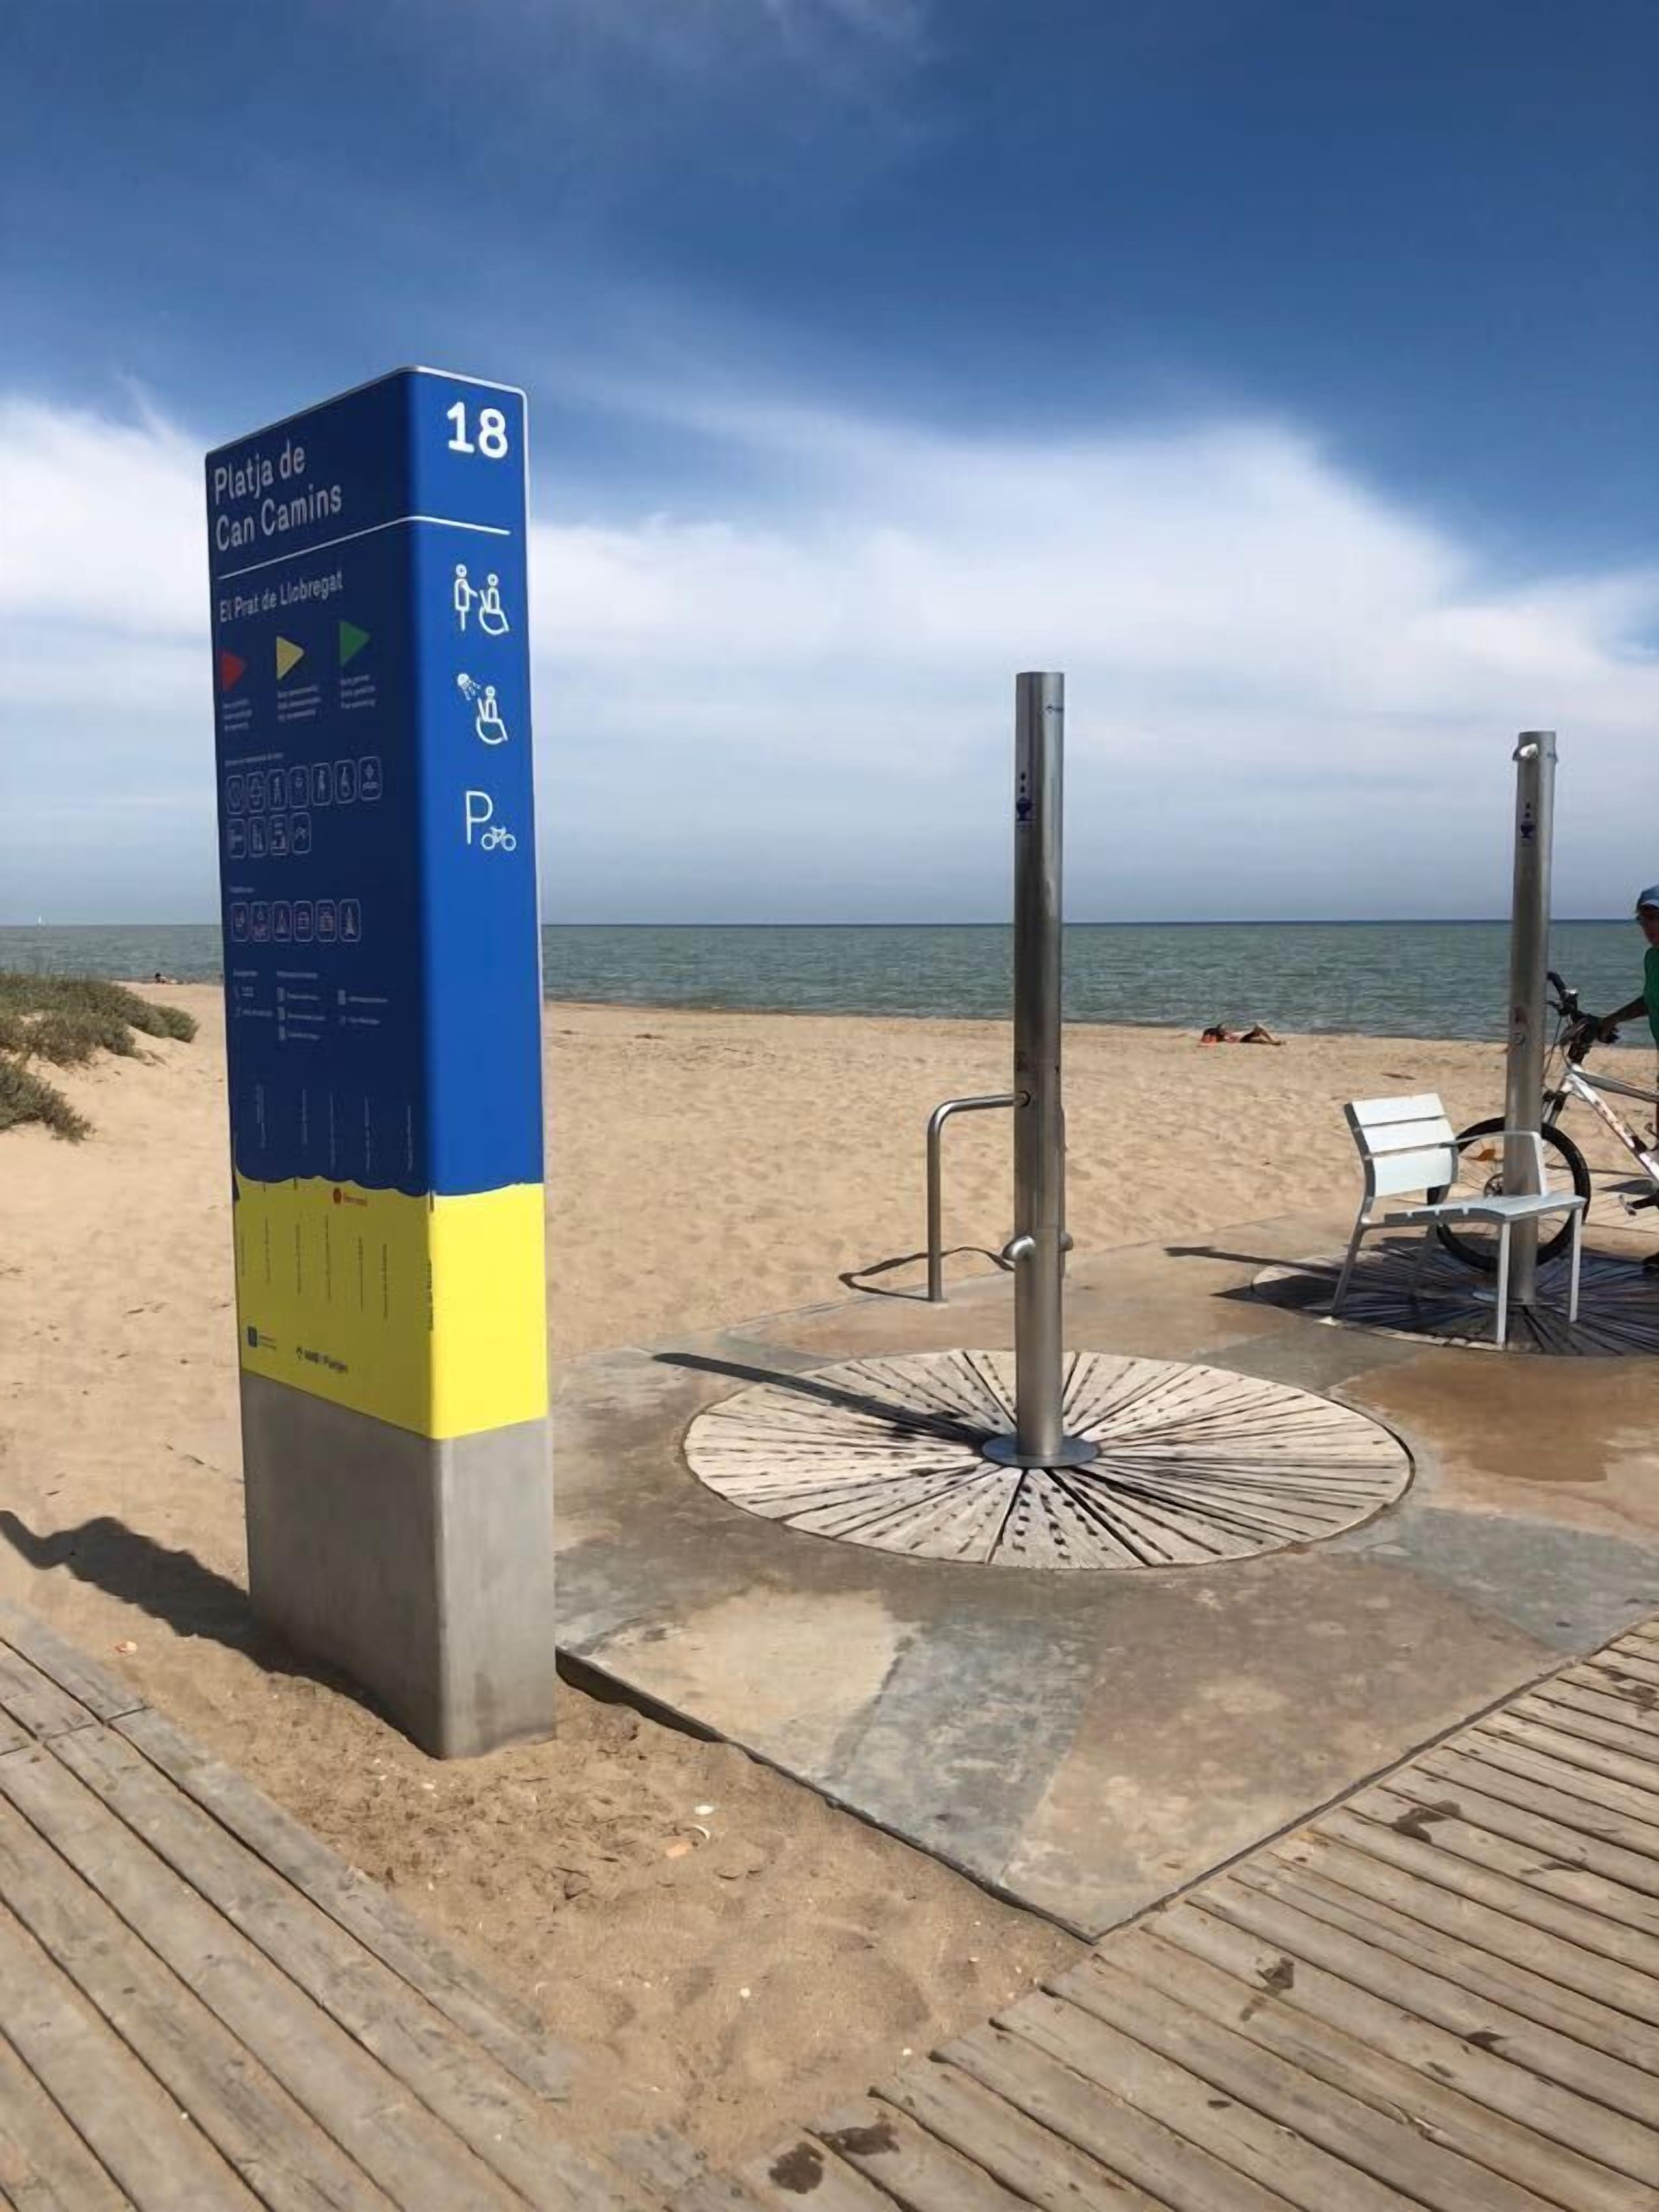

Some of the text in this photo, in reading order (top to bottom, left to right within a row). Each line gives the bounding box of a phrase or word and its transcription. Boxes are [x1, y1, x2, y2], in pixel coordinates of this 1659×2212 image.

[447, 401, 509, 458] 18
[215, 439, 306, 505] Platja de
[217, 484, 342, 551] Can Camins
[220, 570, 343, 622] El Prat de Llobregat
[466, 790, 493, 845] P
